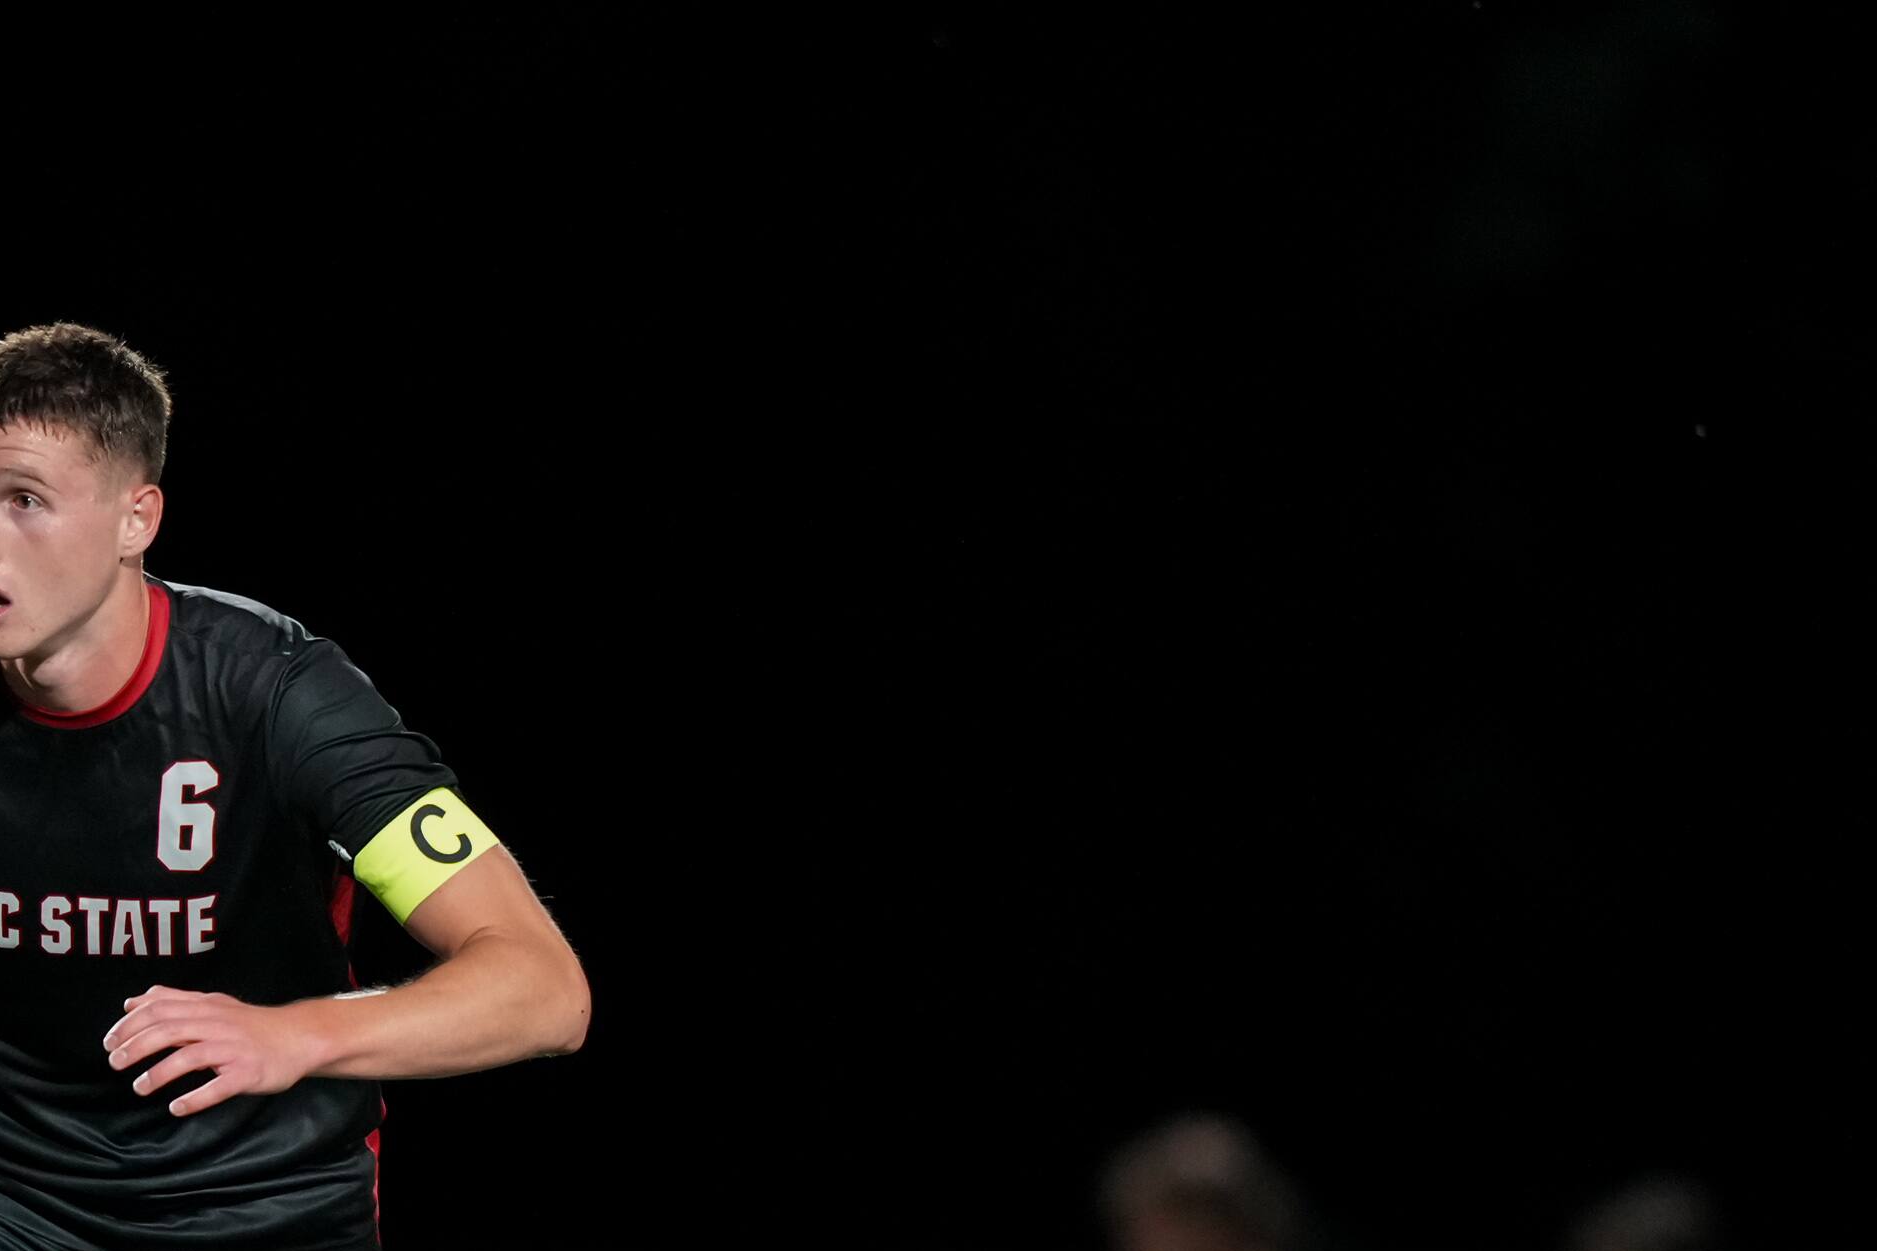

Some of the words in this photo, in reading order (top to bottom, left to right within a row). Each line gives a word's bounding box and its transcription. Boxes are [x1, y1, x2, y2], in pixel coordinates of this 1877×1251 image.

[156, 760, 219, 872] 6
[410, 803, 473, 864] C
[40, 894, 217, 956] STATE
